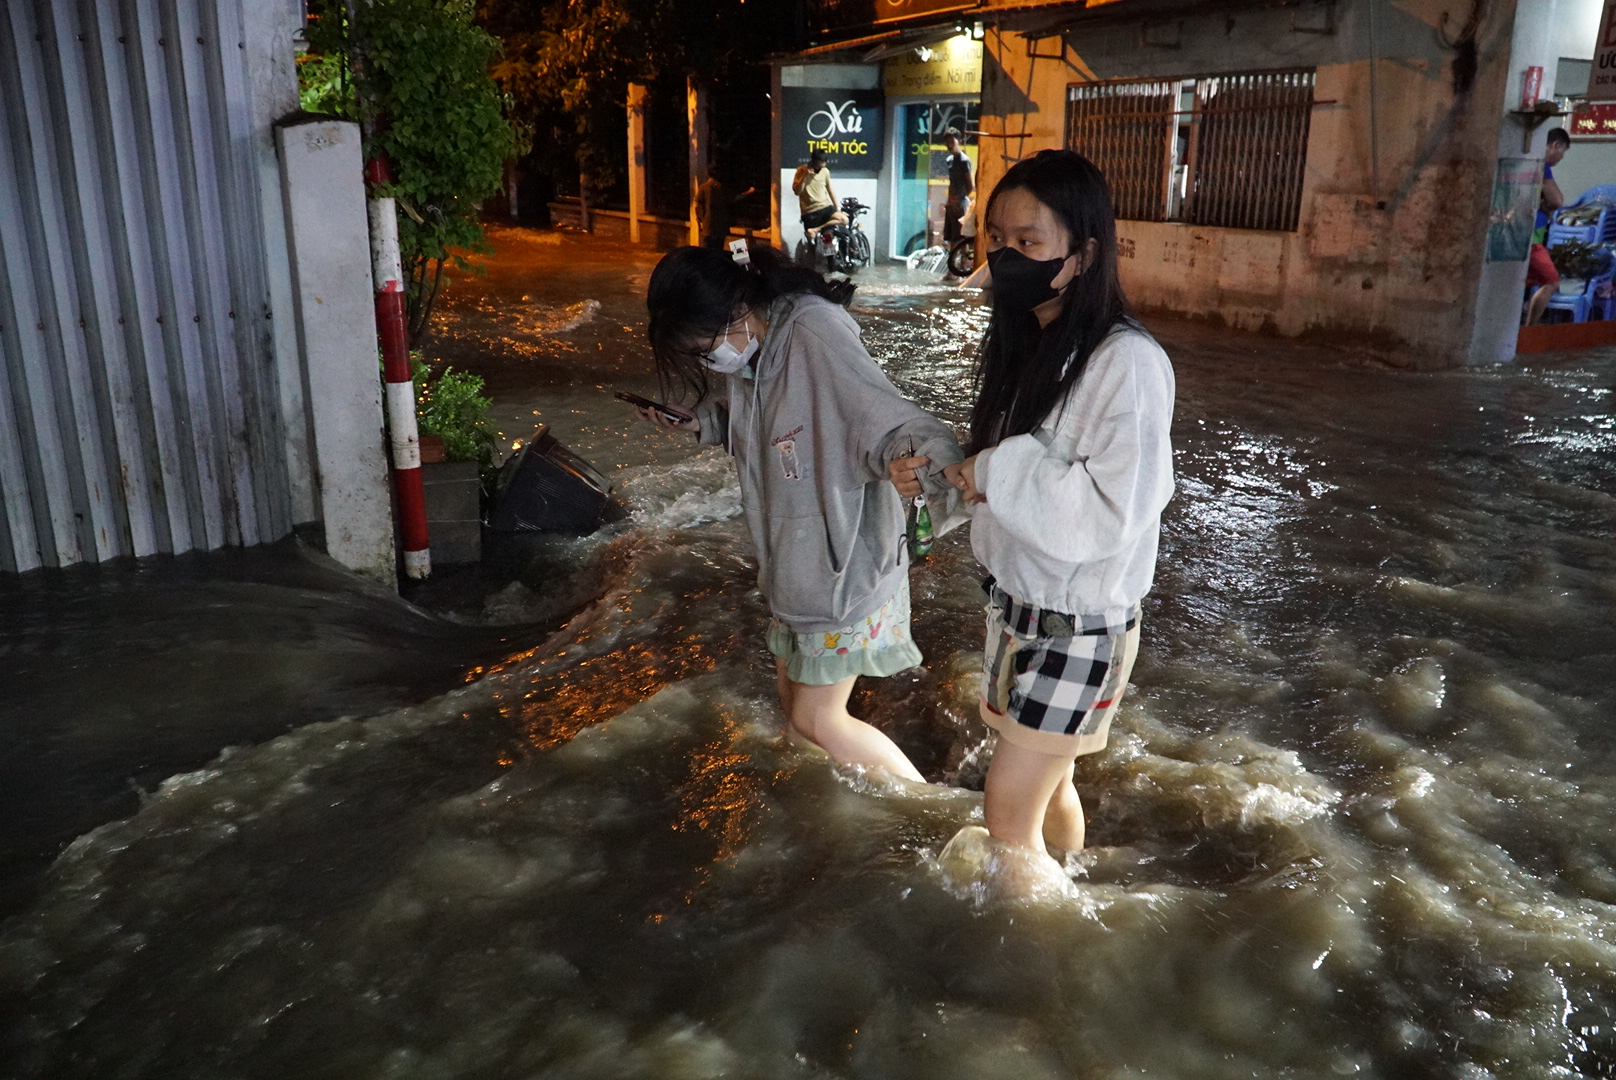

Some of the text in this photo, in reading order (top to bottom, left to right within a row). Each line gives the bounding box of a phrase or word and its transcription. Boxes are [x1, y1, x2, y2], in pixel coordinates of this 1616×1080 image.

[807, 100, 863, 139] Xù
[807, 138, 868, 155] TIỆM TÓC
